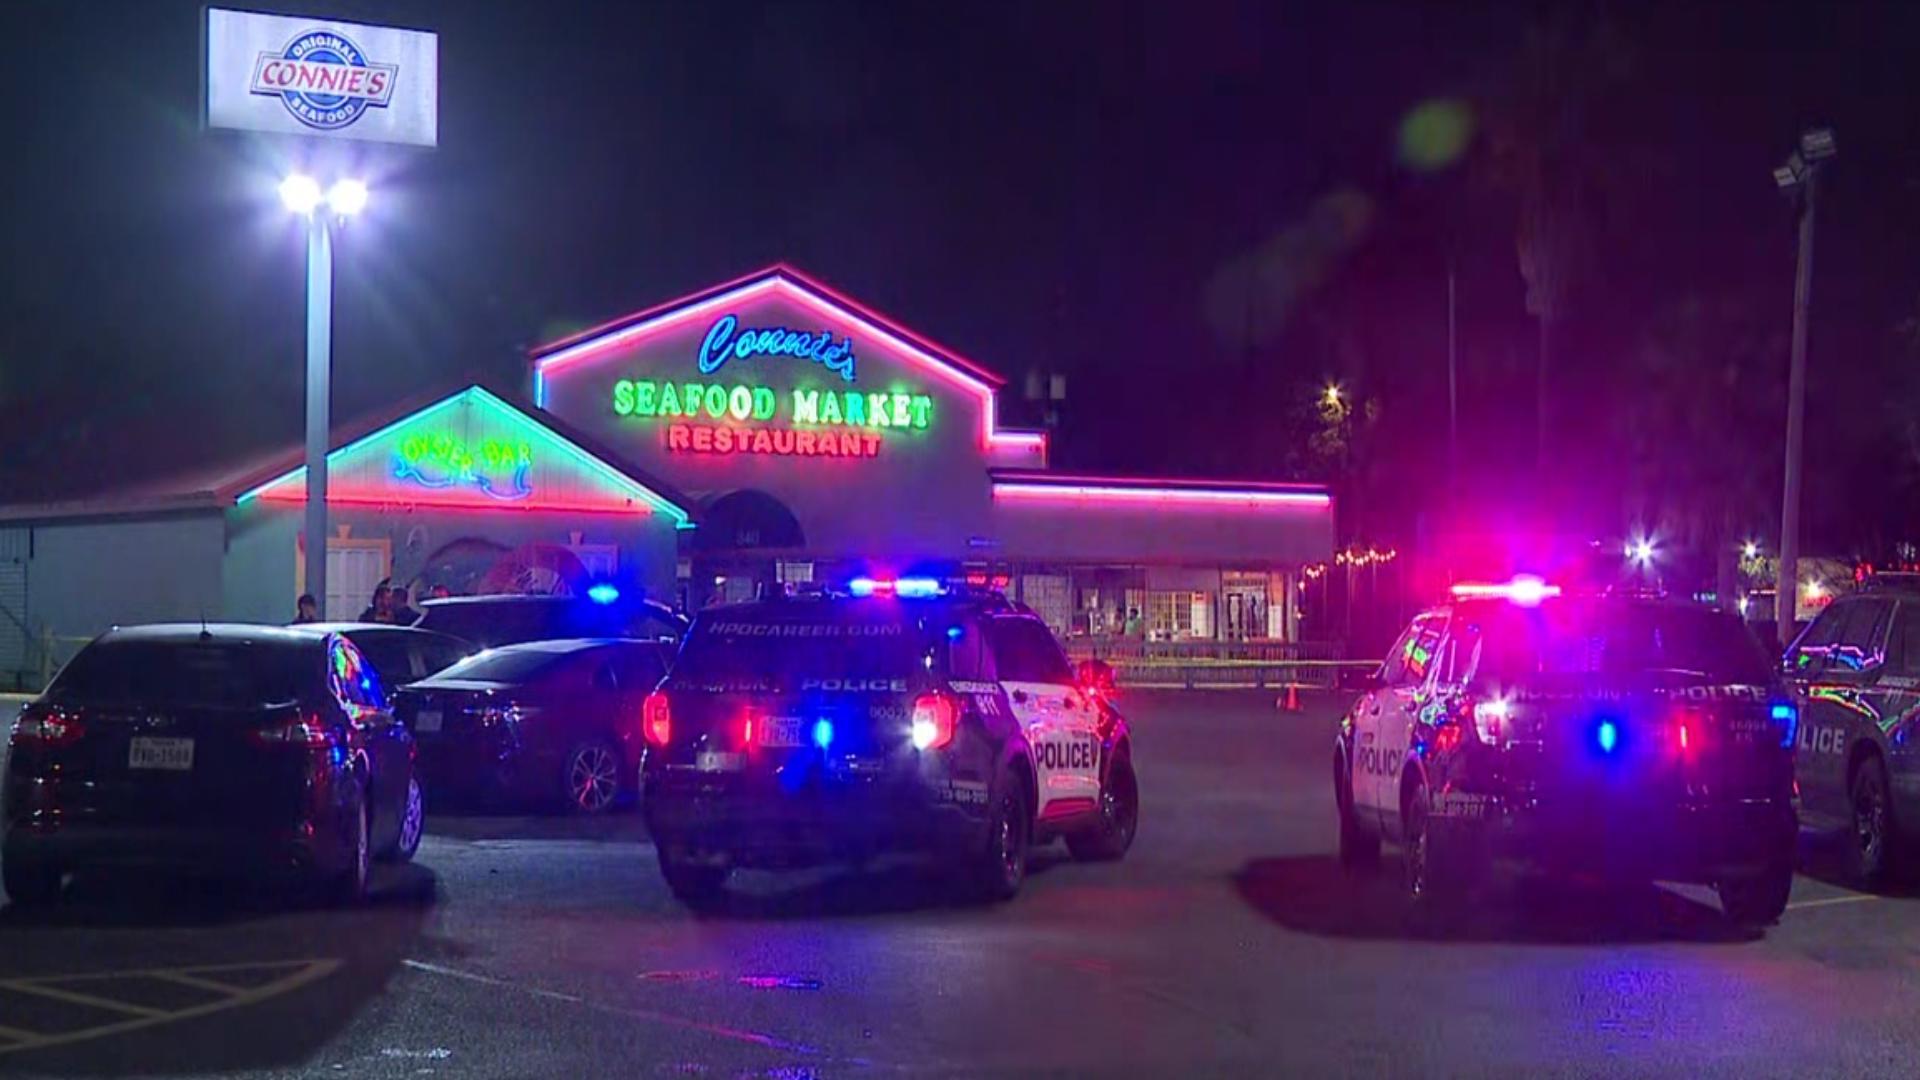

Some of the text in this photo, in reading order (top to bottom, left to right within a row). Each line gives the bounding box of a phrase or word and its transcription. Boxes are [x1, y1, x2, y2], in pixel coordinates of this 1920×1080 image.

[293, 36, 356, 63] ORIGINAL
[263, 62, 386, 95] CONNIE'S
[291, 96, 354, 122] SEAFOOD
[699, 314, 856, 382] Connie's
[613, 380, 932, 427] SEAFOOD MARKET
[668, 425, 881, 456] RESTAURANT
[801, 678, 908, 693] POLICE
[1036, 741, 1091, 770] POLICE
[1797, 724, 1846, 756] LICE
